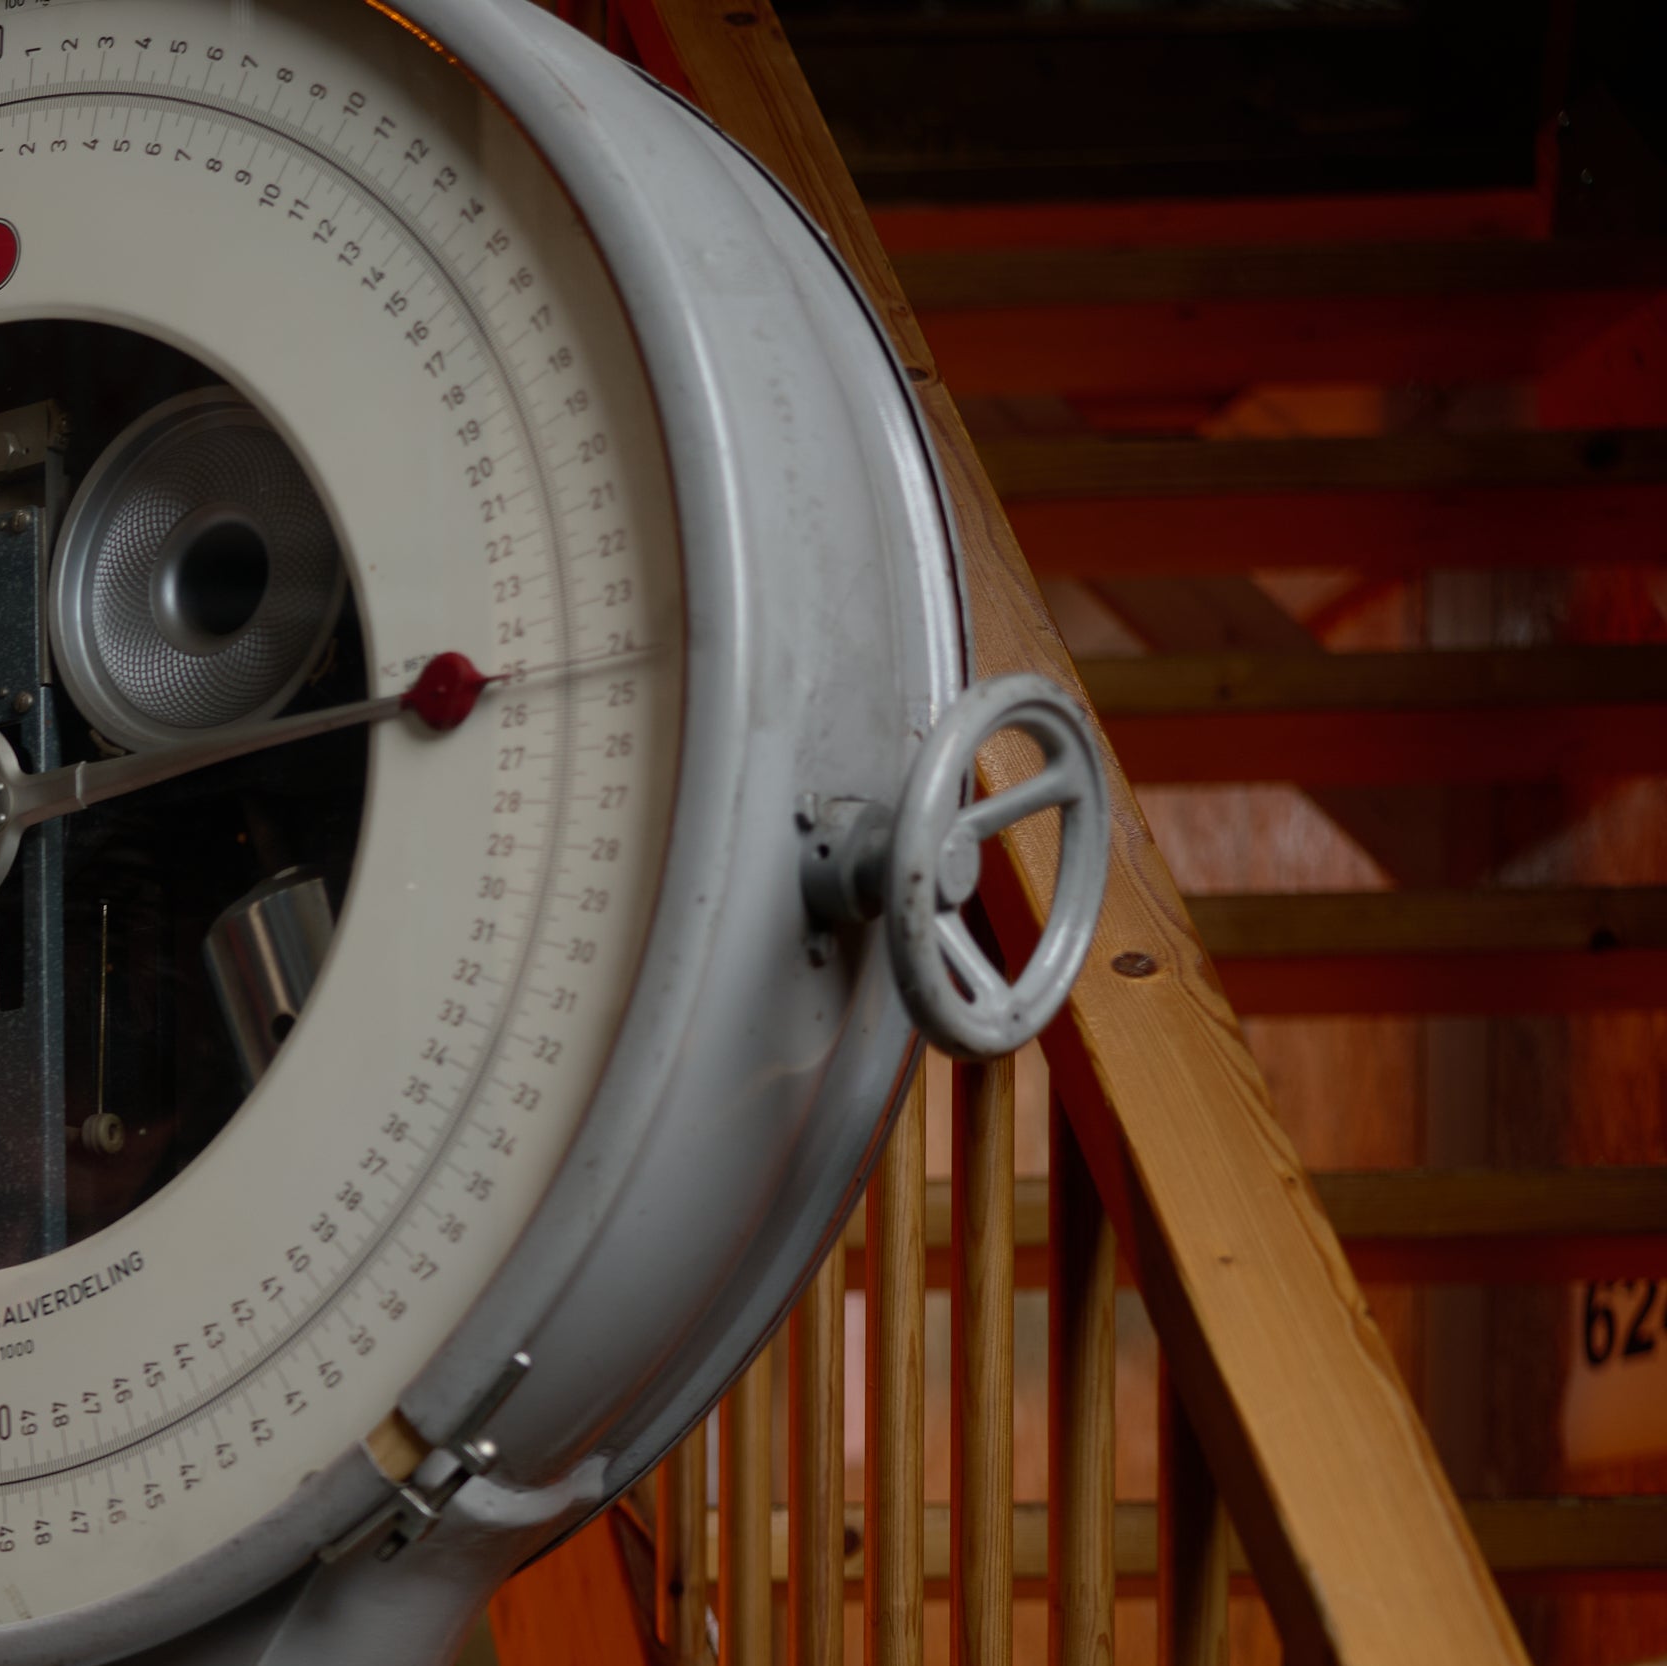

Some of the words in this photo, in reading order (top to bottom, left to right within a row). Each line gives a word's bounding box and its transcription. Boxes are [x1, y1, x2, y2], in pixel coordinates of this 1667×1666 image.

[24, 46, 42, 55] 1
[60, 37, 80, 53] 2
[96, 35, 115, 49] 3
[134, 36, 153, 50] 4
[168, 39, 189, 55] 5
[342, 90, 367, 117] 10
[17, 141, 36, 157] 2
[49, 139, 68, 153] 3
[81, 138, 100, 151] 4
[112, 138, 131, 153] 5
[258, 182, 281, 208] 10
[484, 228, 511, 257] 15
[383, 287, 408, 318] 15
[576, 431, 608, 465] 20
[465, 454, 495, 489] 20
[608, 680, 636, 708] 25
[477, 876, 507, 902] 30
[565, 936, 598, 965] 30
[401, 1074, 431, 1106] 35
[464, 1170, 495, 1202] 35
[285, 1245, 311, 1274] 40
[1585, 1281, 1667, 1364] 62
[0, 1338, 36, 1362] 1000
[142, 1361, 163, 1389] 45
[317, 1359, 344, 1390] 40
[143, 1482, 166, 1510] 45
